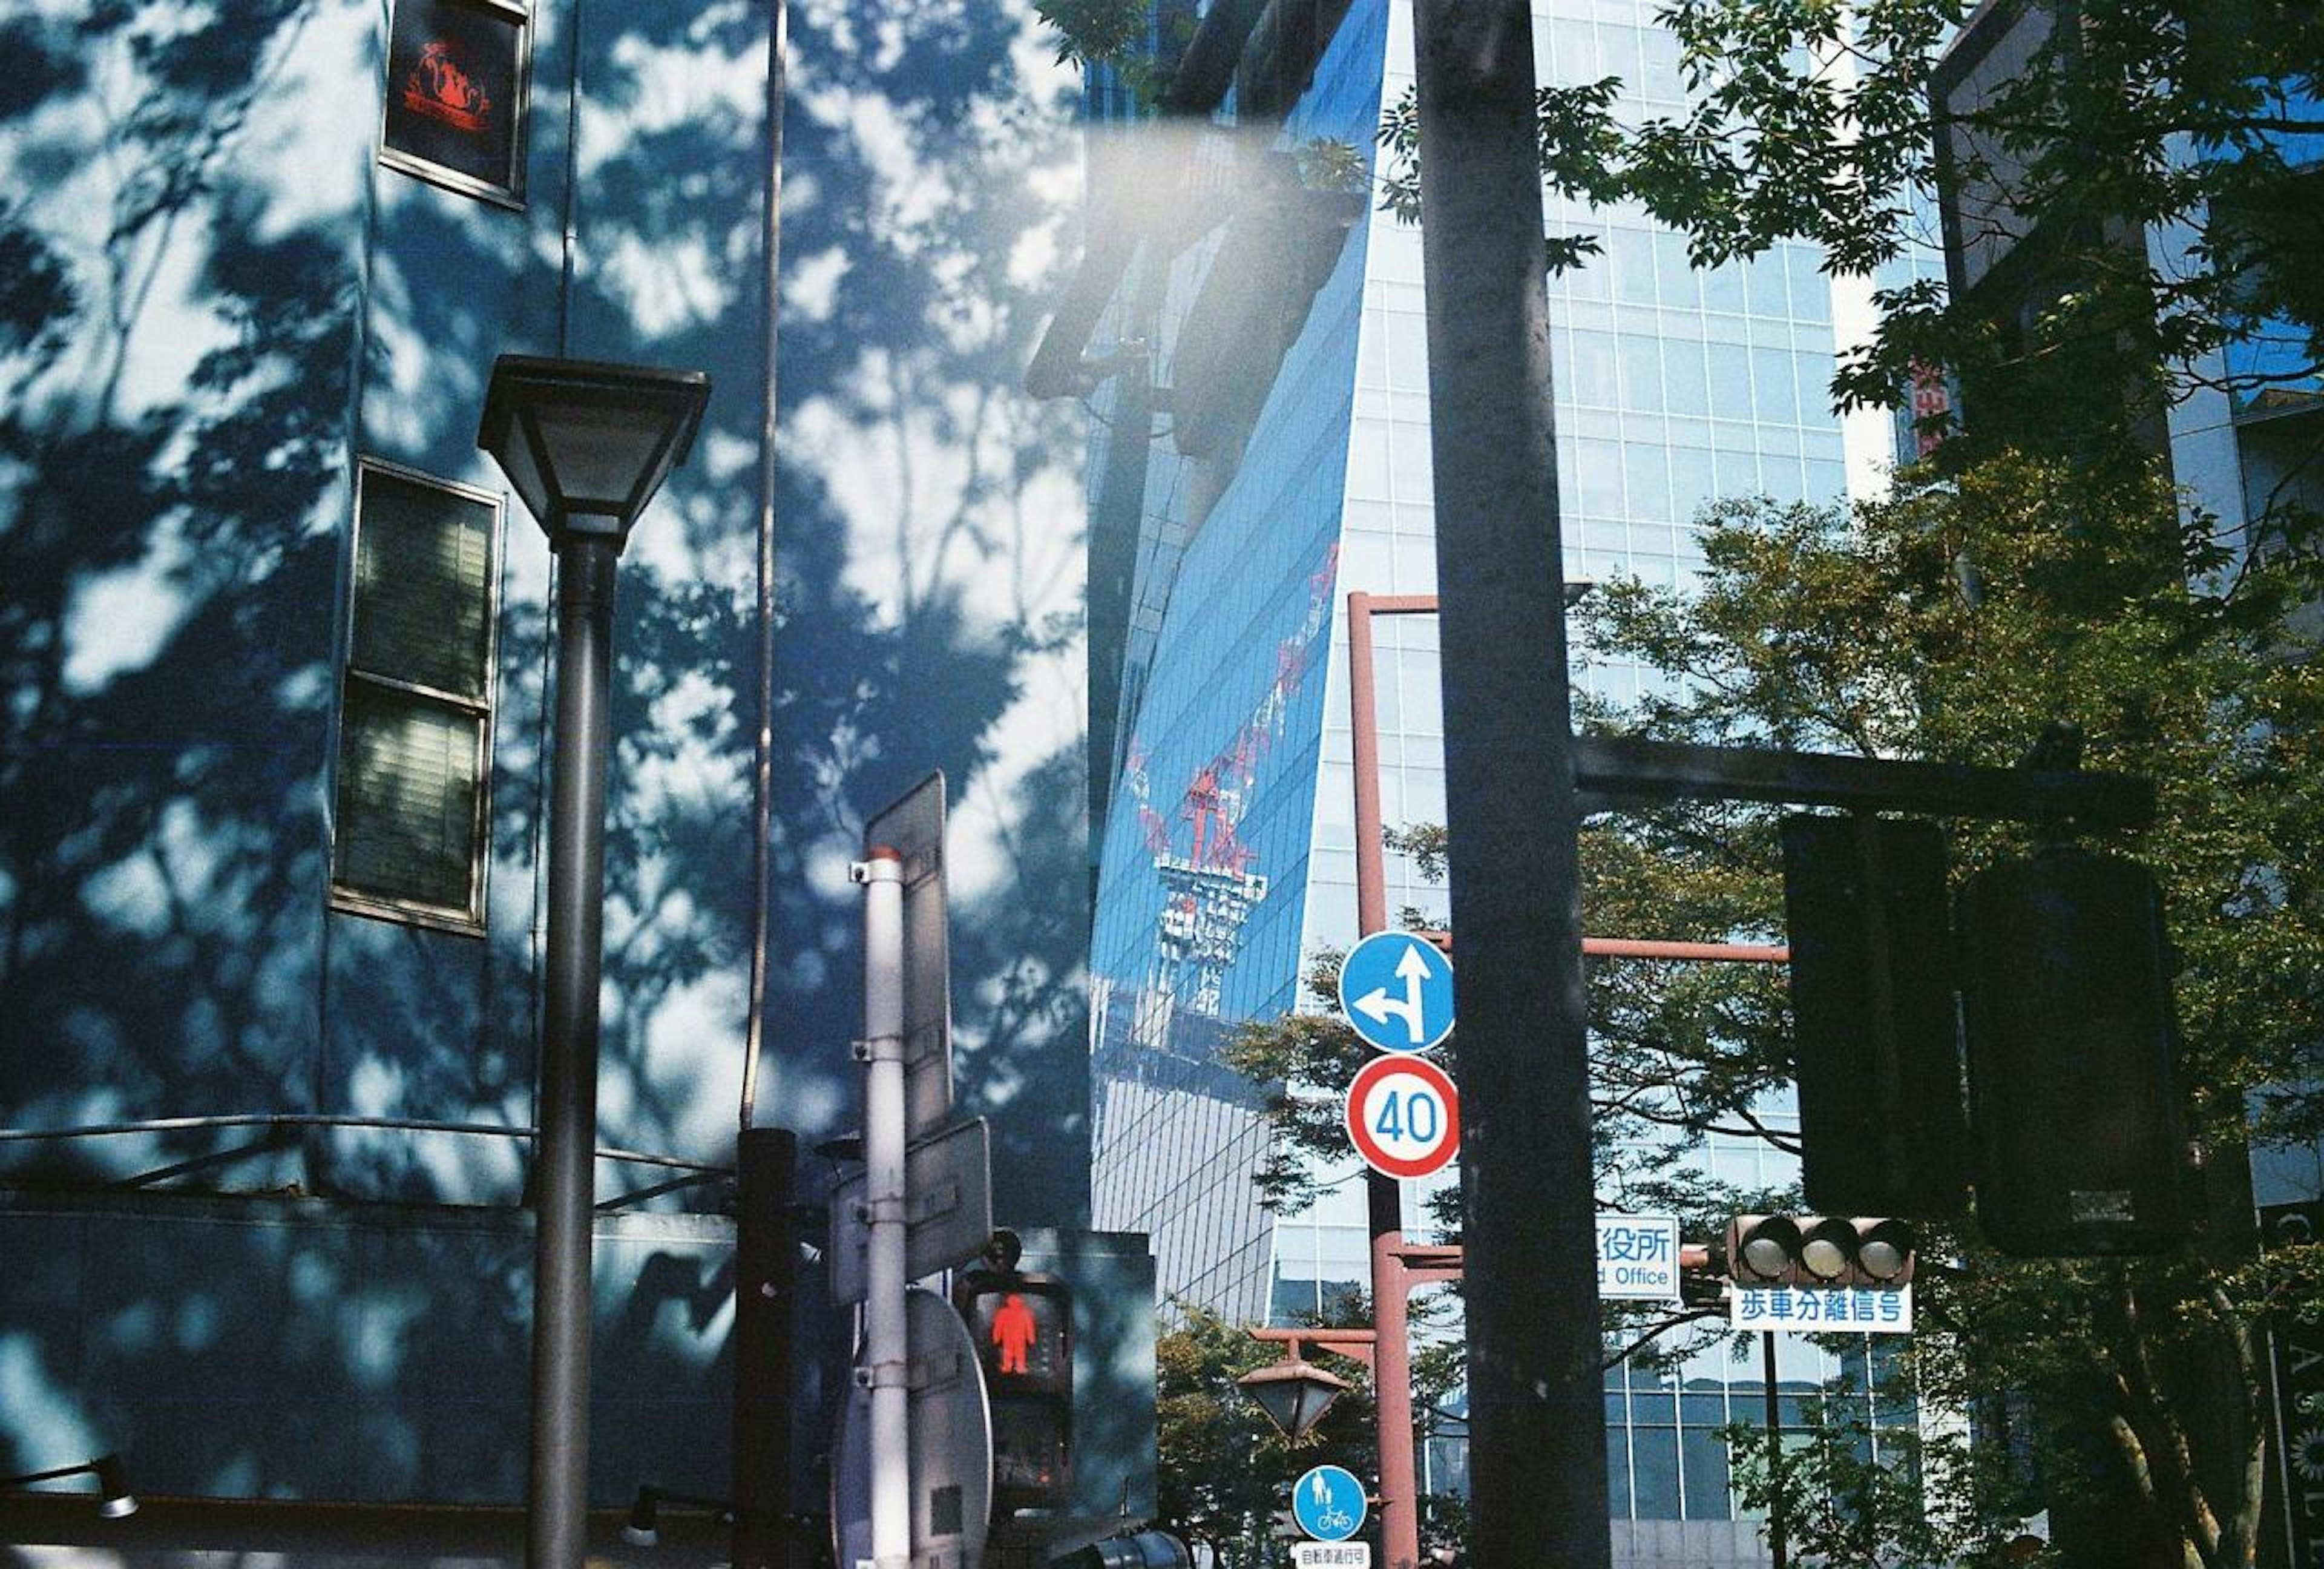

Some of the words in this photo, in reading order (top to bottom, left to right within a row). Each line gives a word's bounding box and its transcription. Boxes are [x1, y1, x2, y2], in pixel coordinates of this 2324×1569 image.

[1376, 1090, 1437, 1143] 40
[1596, 1227, 1670, 1262] 役所
[1616, 1266, 1667, 1284] Office
[1741, 1289, 1902, 1321] 歩車分離信号
